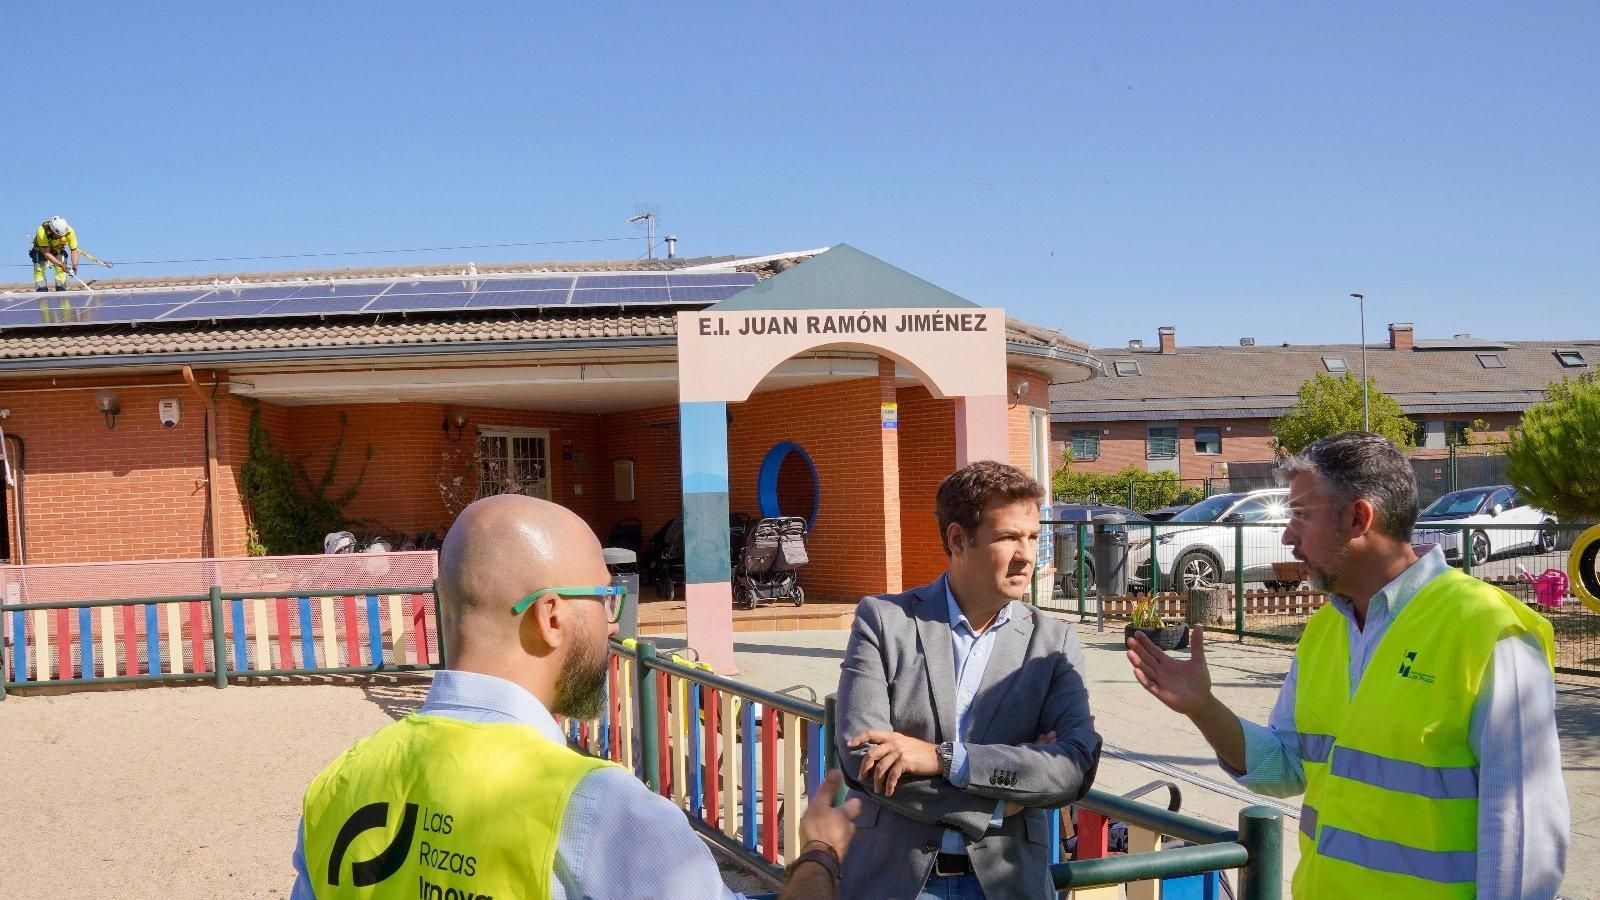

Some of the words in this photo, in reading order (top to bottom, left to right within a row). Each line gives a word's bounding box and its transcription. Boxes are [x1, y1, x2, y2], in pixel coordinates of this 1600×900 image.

[699, 317, 730, 335] E.I.
[739, 316, 798, 335] JUAN
[806, 310, 887, 334] RAMÓN
[895, 309, 987, 332] JIMÉNEZ
[423, 807, 454, 834] Las
[419, 841, 477, 877] Rozas
